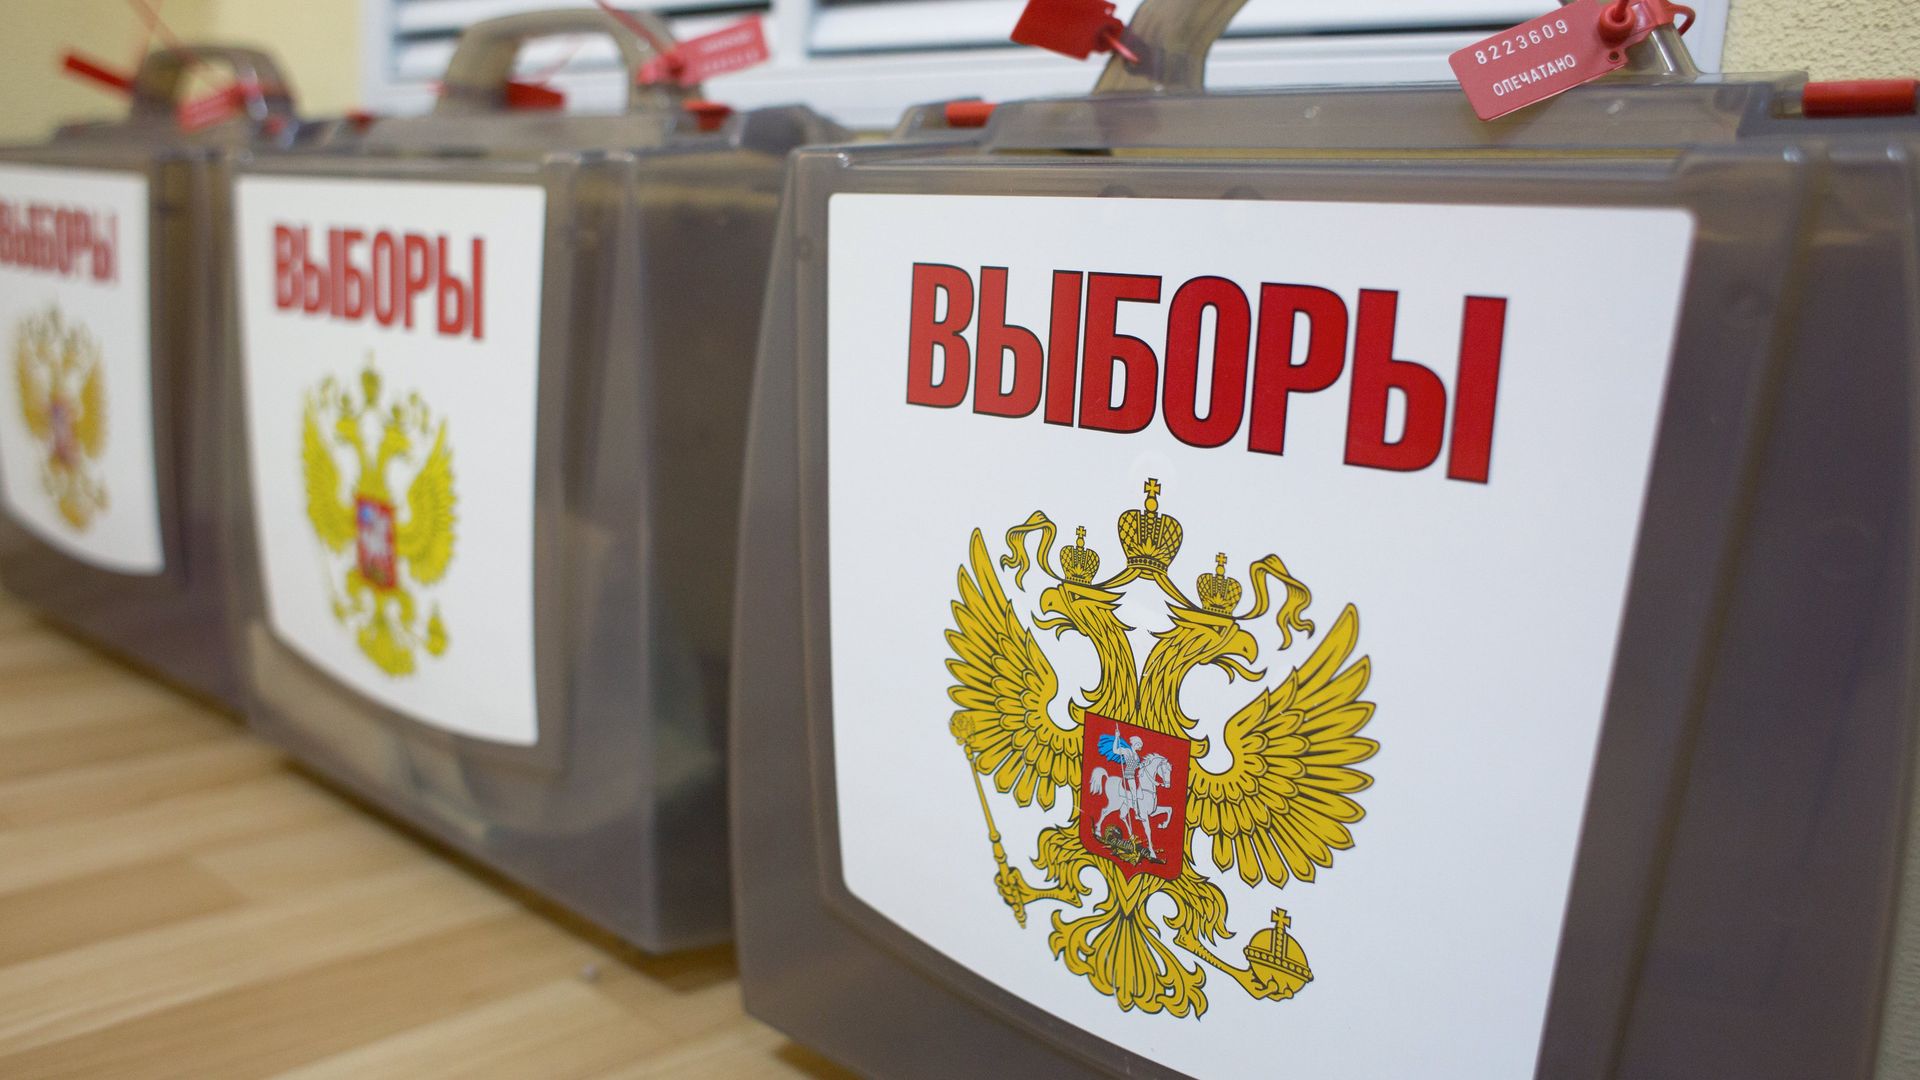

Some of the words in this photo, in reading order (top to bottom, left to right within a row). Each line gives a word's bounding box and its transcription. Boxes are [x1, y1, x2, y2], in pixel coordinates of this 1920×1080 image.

[1474, 19, 1569, 65] 8223609
[1492, 54, 1577, 97] ОПЕЧАТАНО
[273, 222, 486, 341] ВЫБОРЫ
[905, 261, 1509, 485] ВЫБОРЫ
